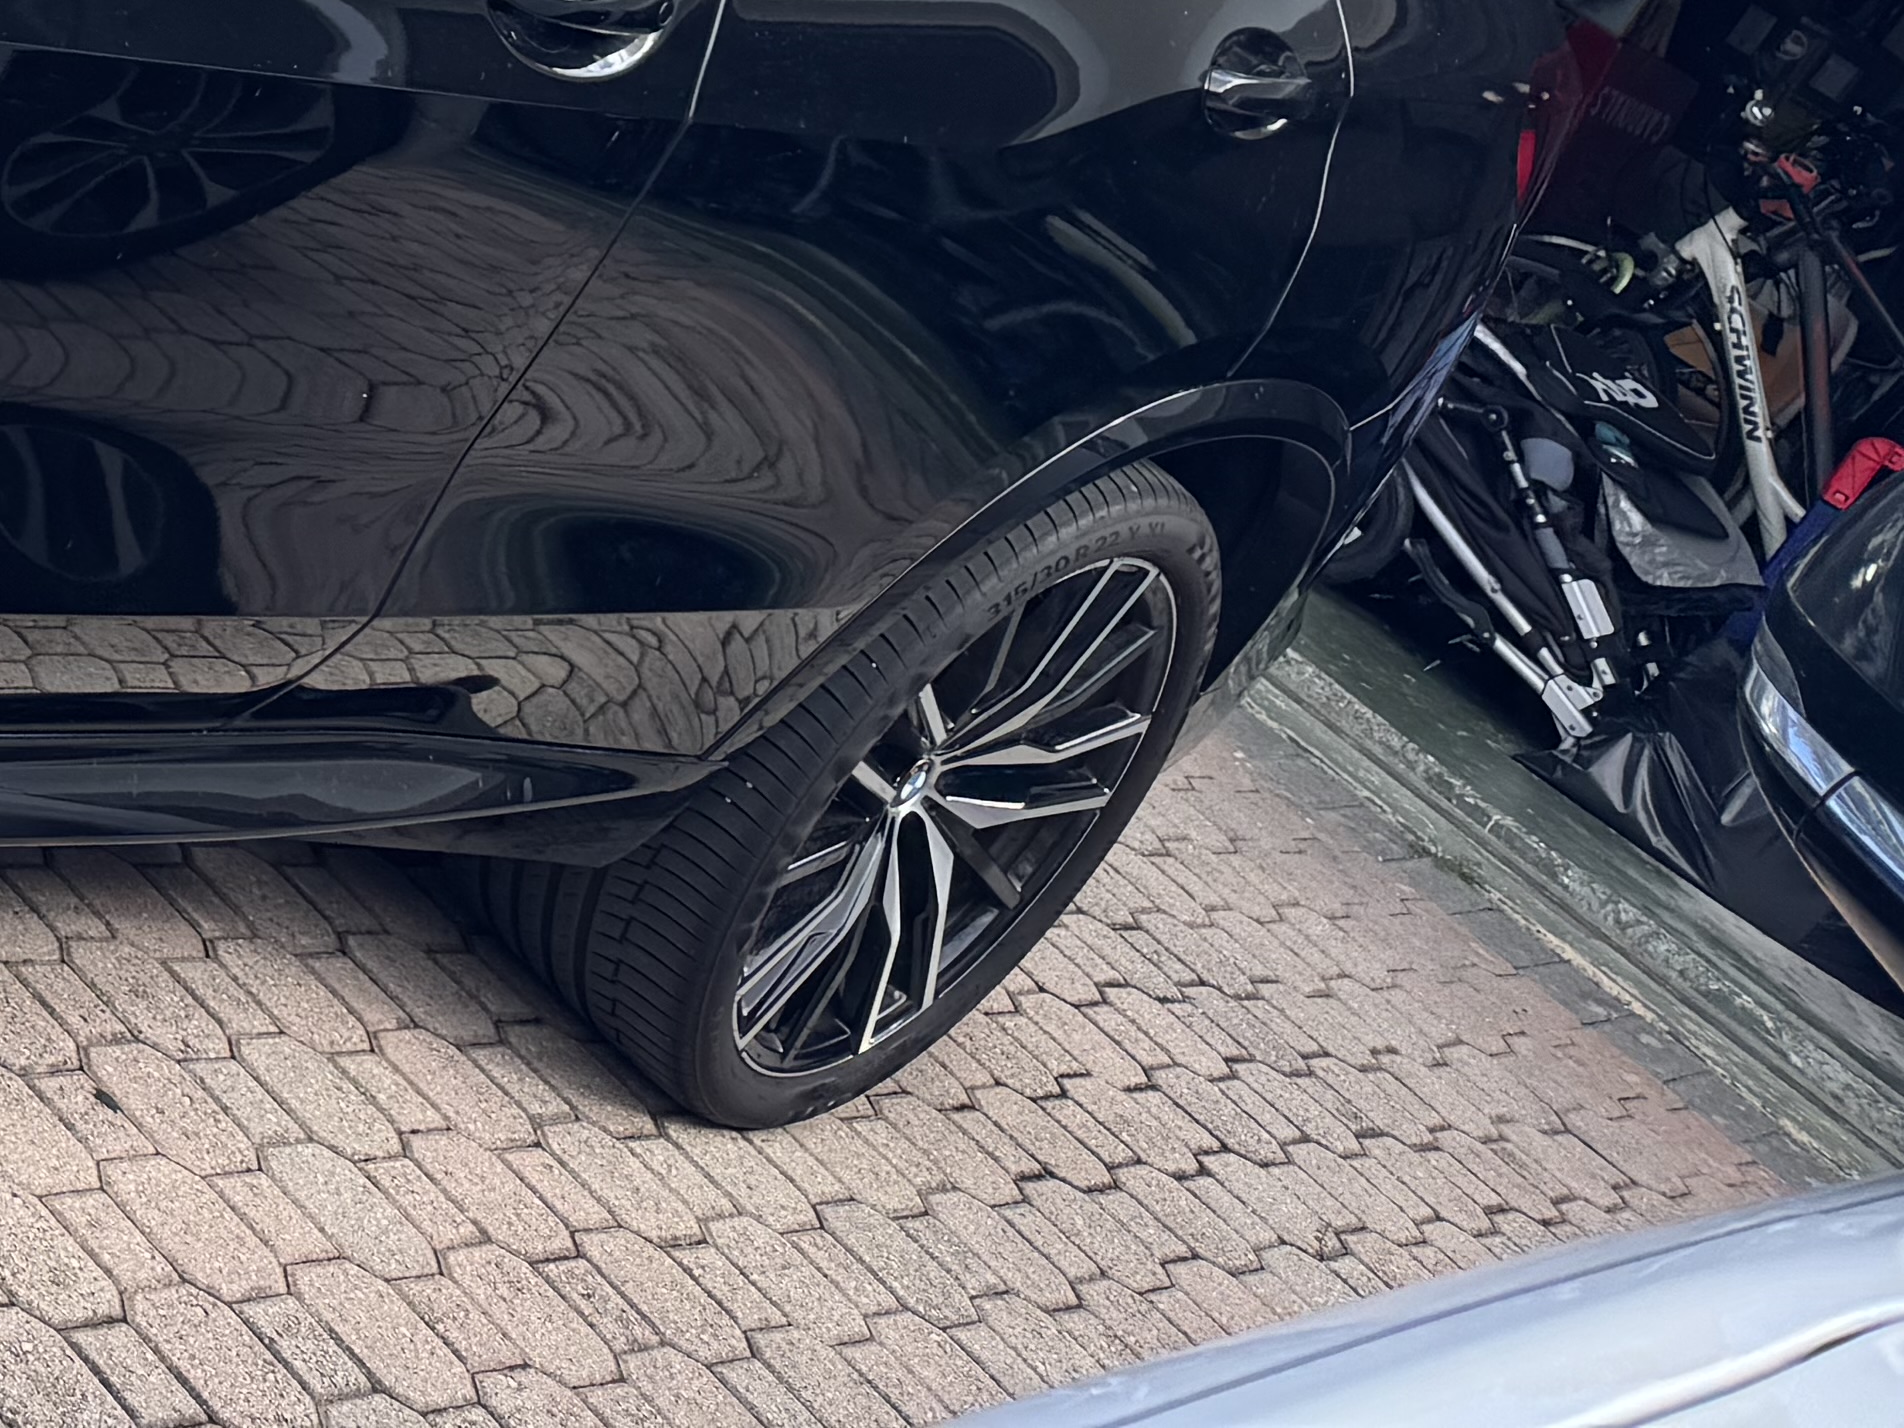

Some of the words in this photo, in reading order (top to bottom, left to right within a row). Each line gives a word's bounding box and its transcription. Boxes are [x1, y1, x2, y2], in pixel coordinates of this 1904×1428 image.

[1727, 285, 1763, 443] SCHWINN
[986, 554, 1071, 622] 315/30
[1074, 544, 1090, 564] R
[1094, 530, 1120, 553] 22
